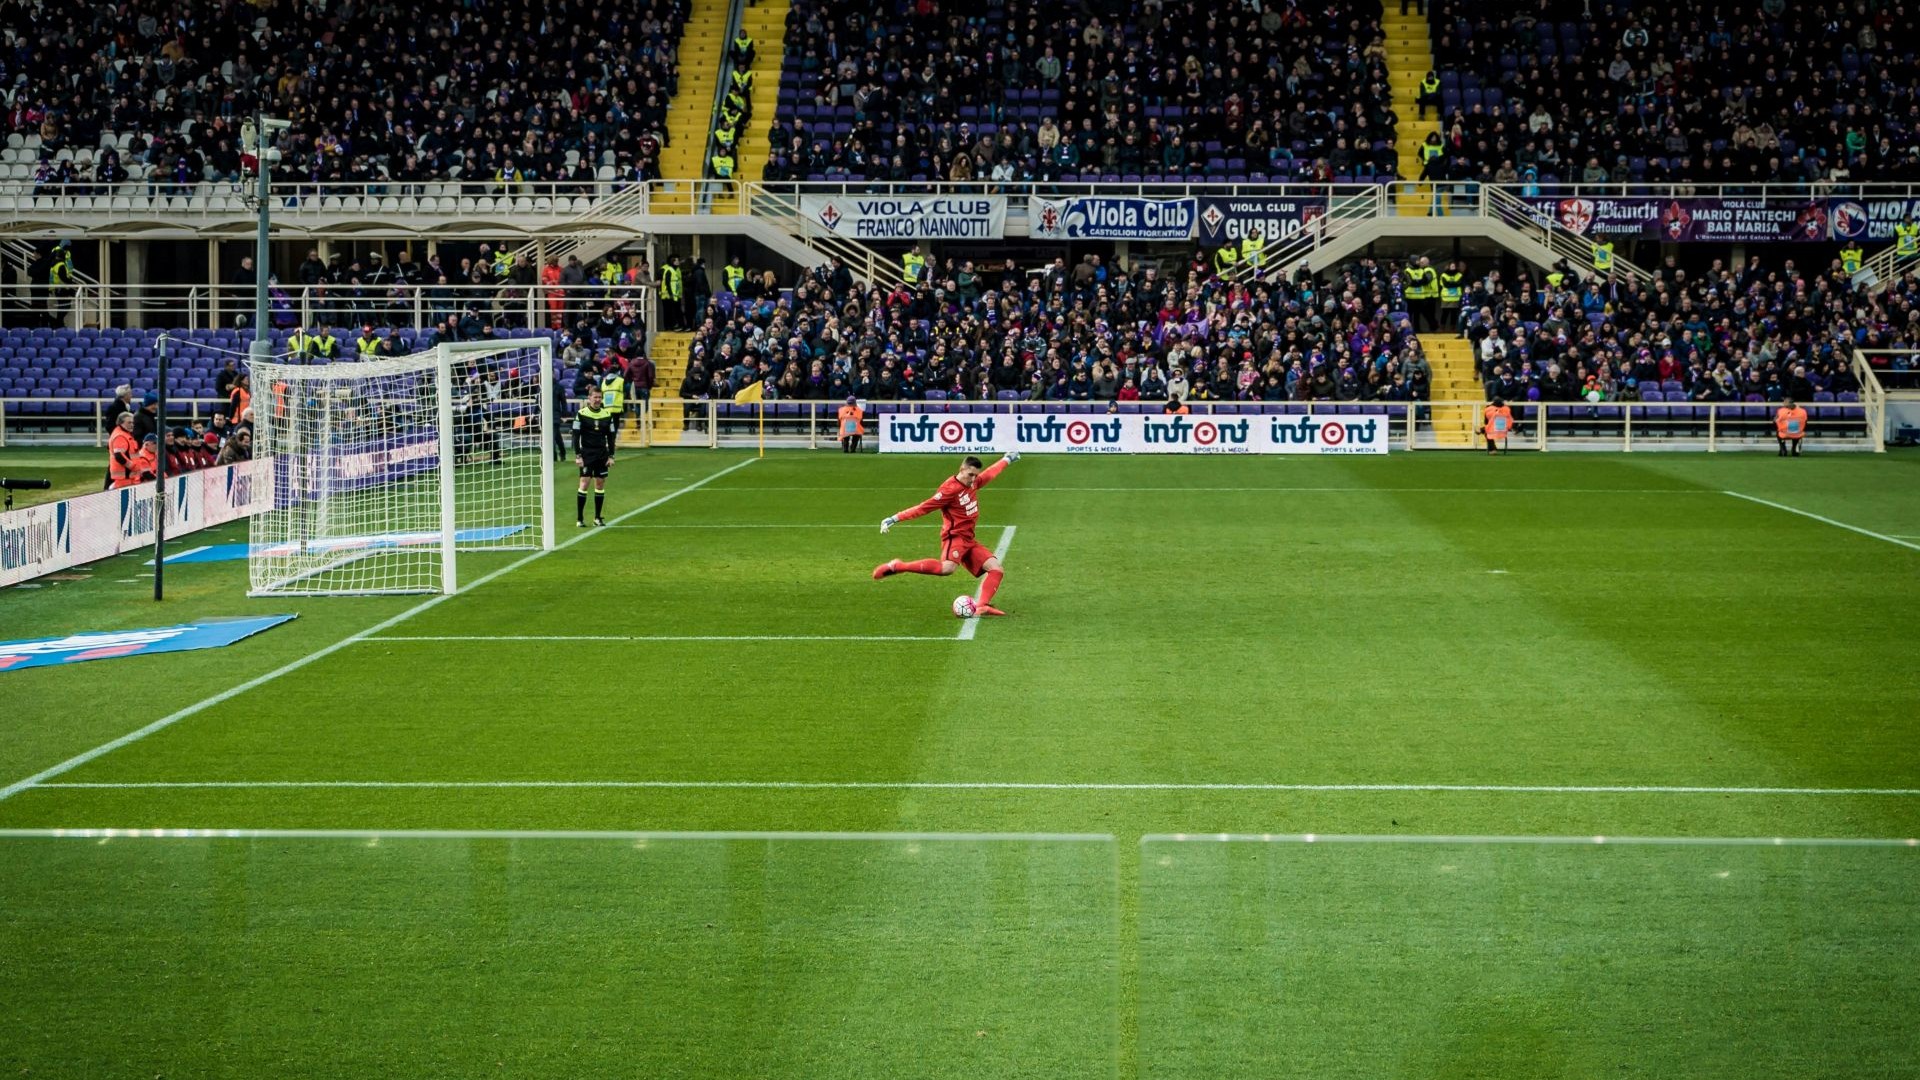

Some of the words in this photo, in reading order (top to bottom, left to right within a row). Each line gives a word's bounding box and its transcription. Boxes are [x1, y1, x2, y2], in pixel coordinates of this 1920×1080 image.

[858, 201, 924, 216] VIOLA
[933, 200, 991, 215] CLUB
[1086, 200, 1138, 228] Viola
[1143, 202, 1188, 228] Club
[1229, 203, 1262, 212] VIOLA
[1266, 203, 1296, 212] CLUB
[1596, 200, 1659, 220] Bianchi
[1693, 210, 1732, 221] MARIO
[1736, 210, 1796, 222] FANTECHI
[857, 218, 914, 236] FRANCO
[920, 218, 990, 236] NANNOTTI
[1090, 228, 1137, 237] CASTIGLION
[1138, 229, 1188, 238] FIORENTINO
[1225, 218, 1301, 240] GUBBIO
[1707, 222, 1731, 233] BAR
[1735, 222, 1780, 233] MARISA
[890, 415, 996, 444] infront
[1016, 416, 1122, 444] infront
[1144, 416, 1250, 445] infront
[1272, 416, 1377, 445] infront
